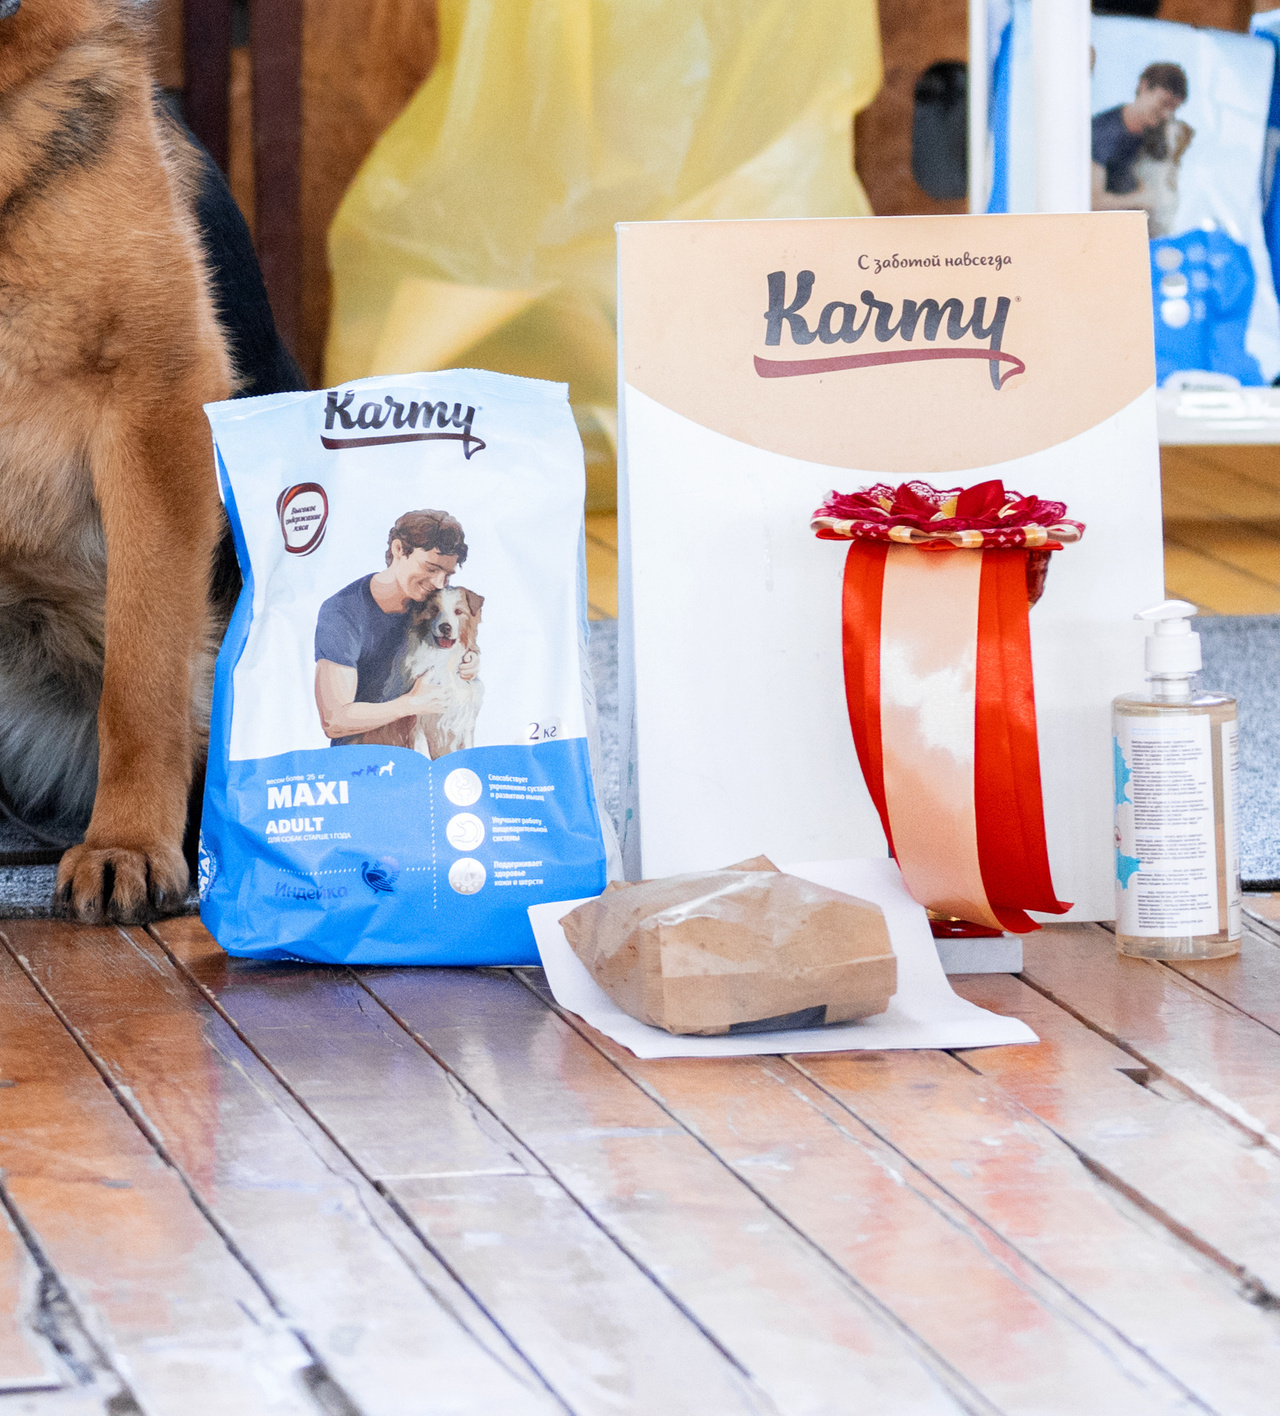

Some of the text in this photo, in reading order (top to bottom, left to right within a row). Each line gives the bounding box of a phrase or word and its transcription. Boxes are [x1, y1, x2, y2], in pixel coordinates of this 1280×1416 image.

[857, 251, 1013, 274] С заботой навсегда
[763, 270, 1011, 391] Karmy
[323, 390, 476, 460] Karmy
[528, 722, 557, 740] 2 кг
[307, 773, 316, 781] 25
[267, 780, 349, 810] MAXI
[265, 817, 325, 834] ADULT
[275, 881, 347, 900] Индейка
